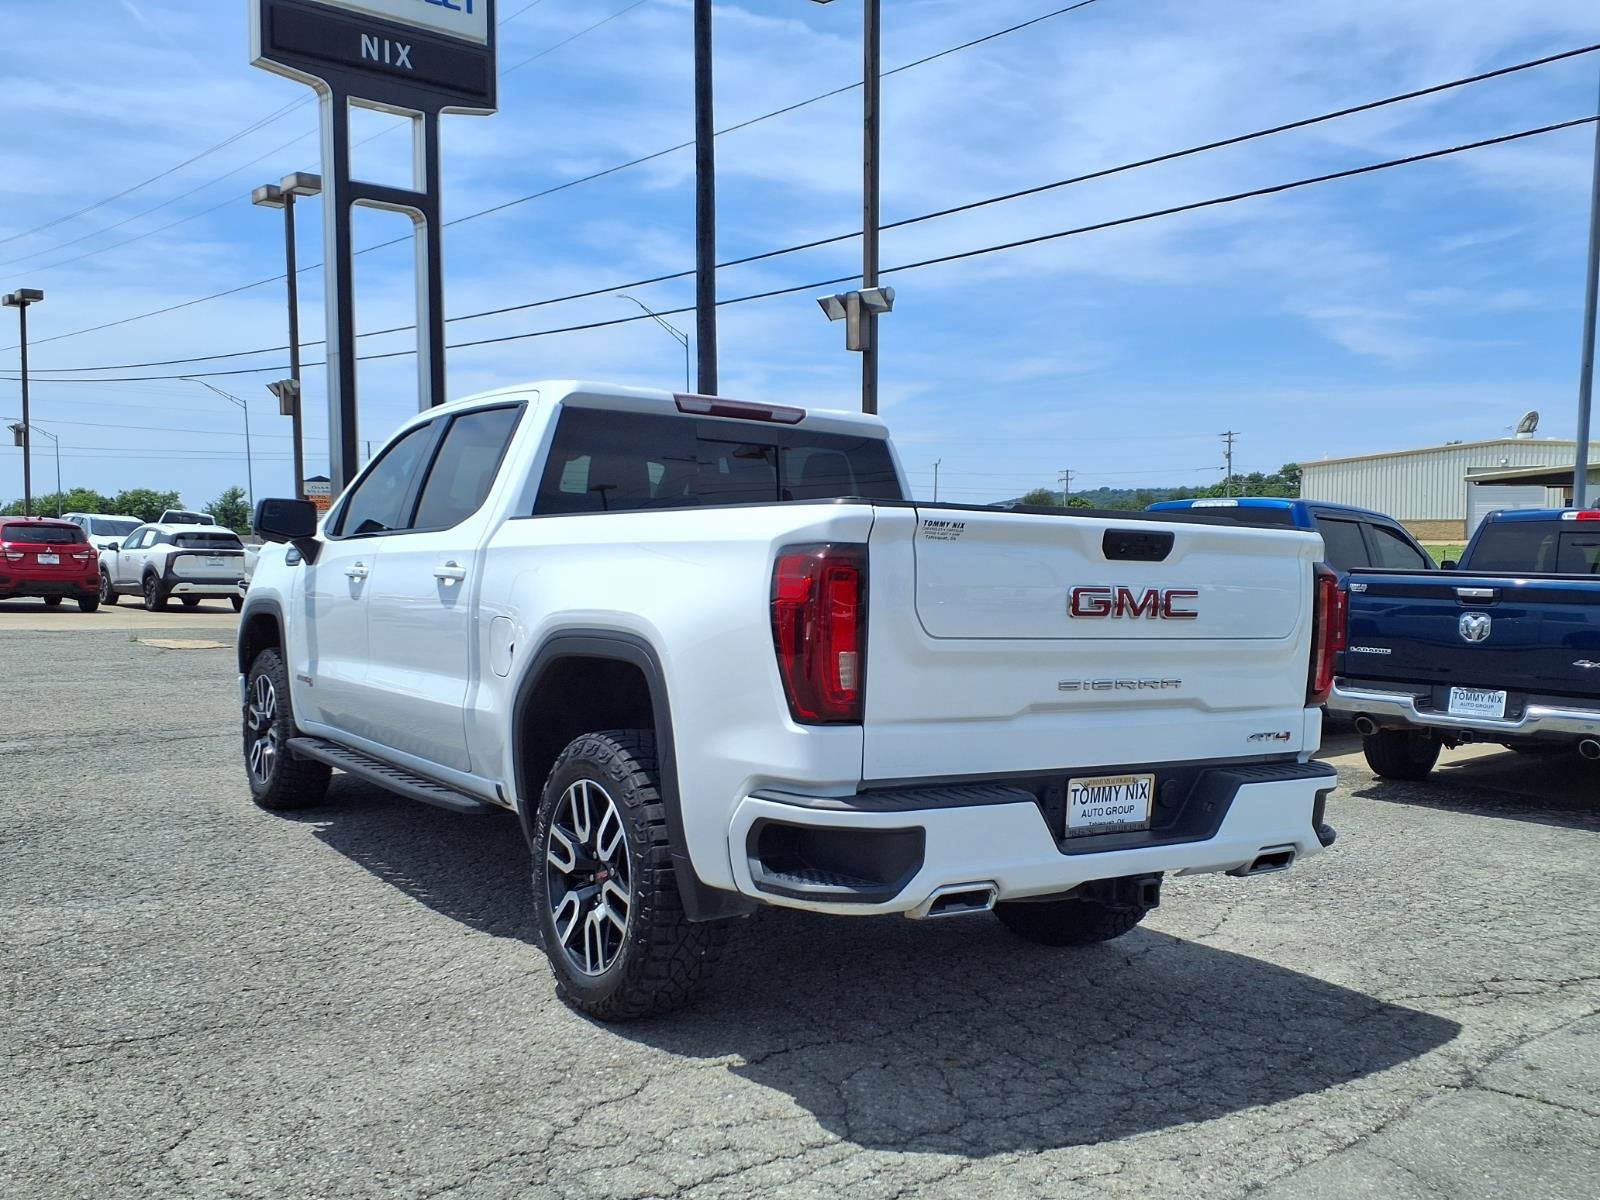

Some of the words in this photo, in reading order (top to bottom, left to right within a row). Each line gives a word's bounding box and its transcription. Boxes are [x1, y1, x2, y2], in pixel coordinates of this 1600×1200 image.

[361, 33, 413, 69] NIX
[924, 520, 950, 528] TOMMY
[1067, 585, 1199, 619] GMC
[1058, 678, 1182, 691] SIERRA
[1453, 691, 1486, 702] TOMMY
[1487, 694, 1504, 704] NIX
[1247, 731, 1291, 743] AT4
[1071, 785, 1121, 806] TOMMY
[1125, 782, 1148, 800] NIX
[1081, 807, 1104, 818] AUTO
[1105, 804, 1135, 816] GROUP
